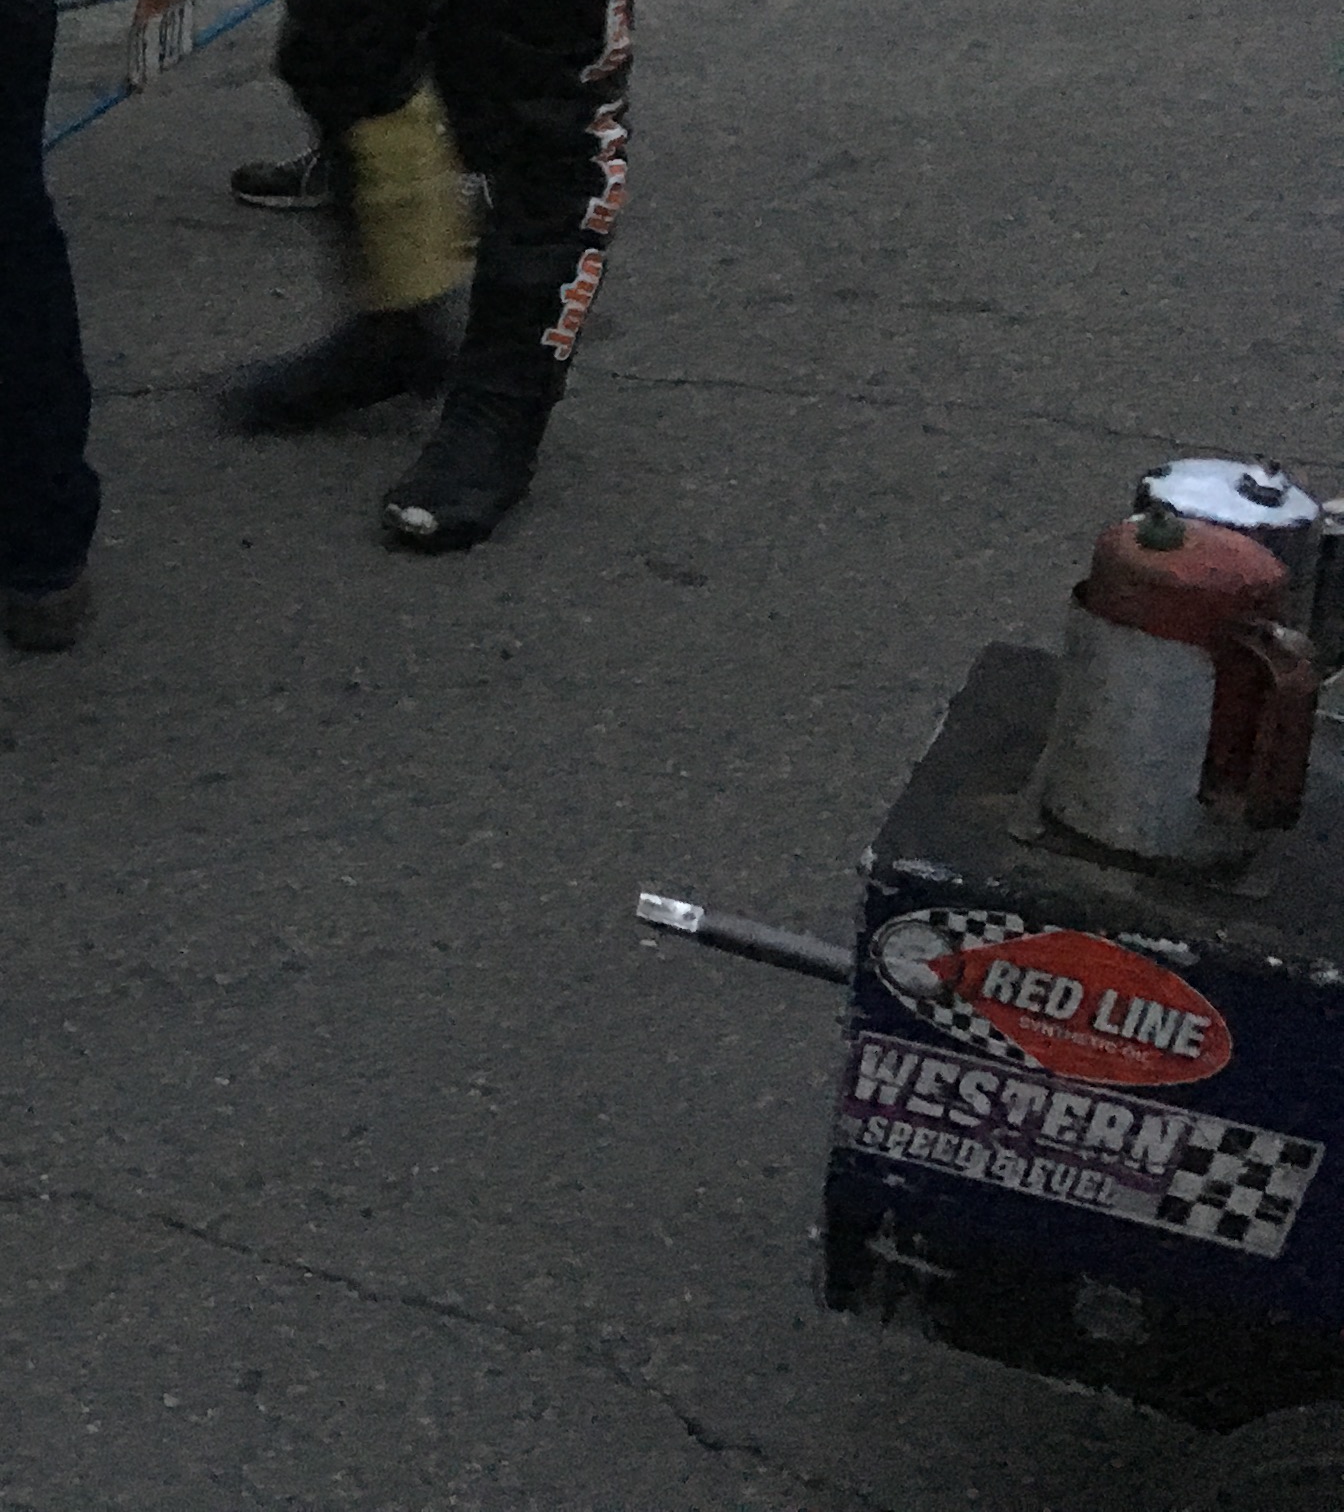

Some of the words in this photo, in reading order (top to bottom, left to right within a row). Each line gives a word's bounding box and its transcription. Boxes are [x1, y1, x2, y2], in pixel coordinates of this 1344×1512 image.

[982, 959, 1084, 1020] RED
[1093, 990, 1211, 1058] LINE
[855, 1045, 1191, 1173] WESTERN
[863, 1117, 989, 1178] SPEED
[1024, 1159, 1114, 1203] FUEL
